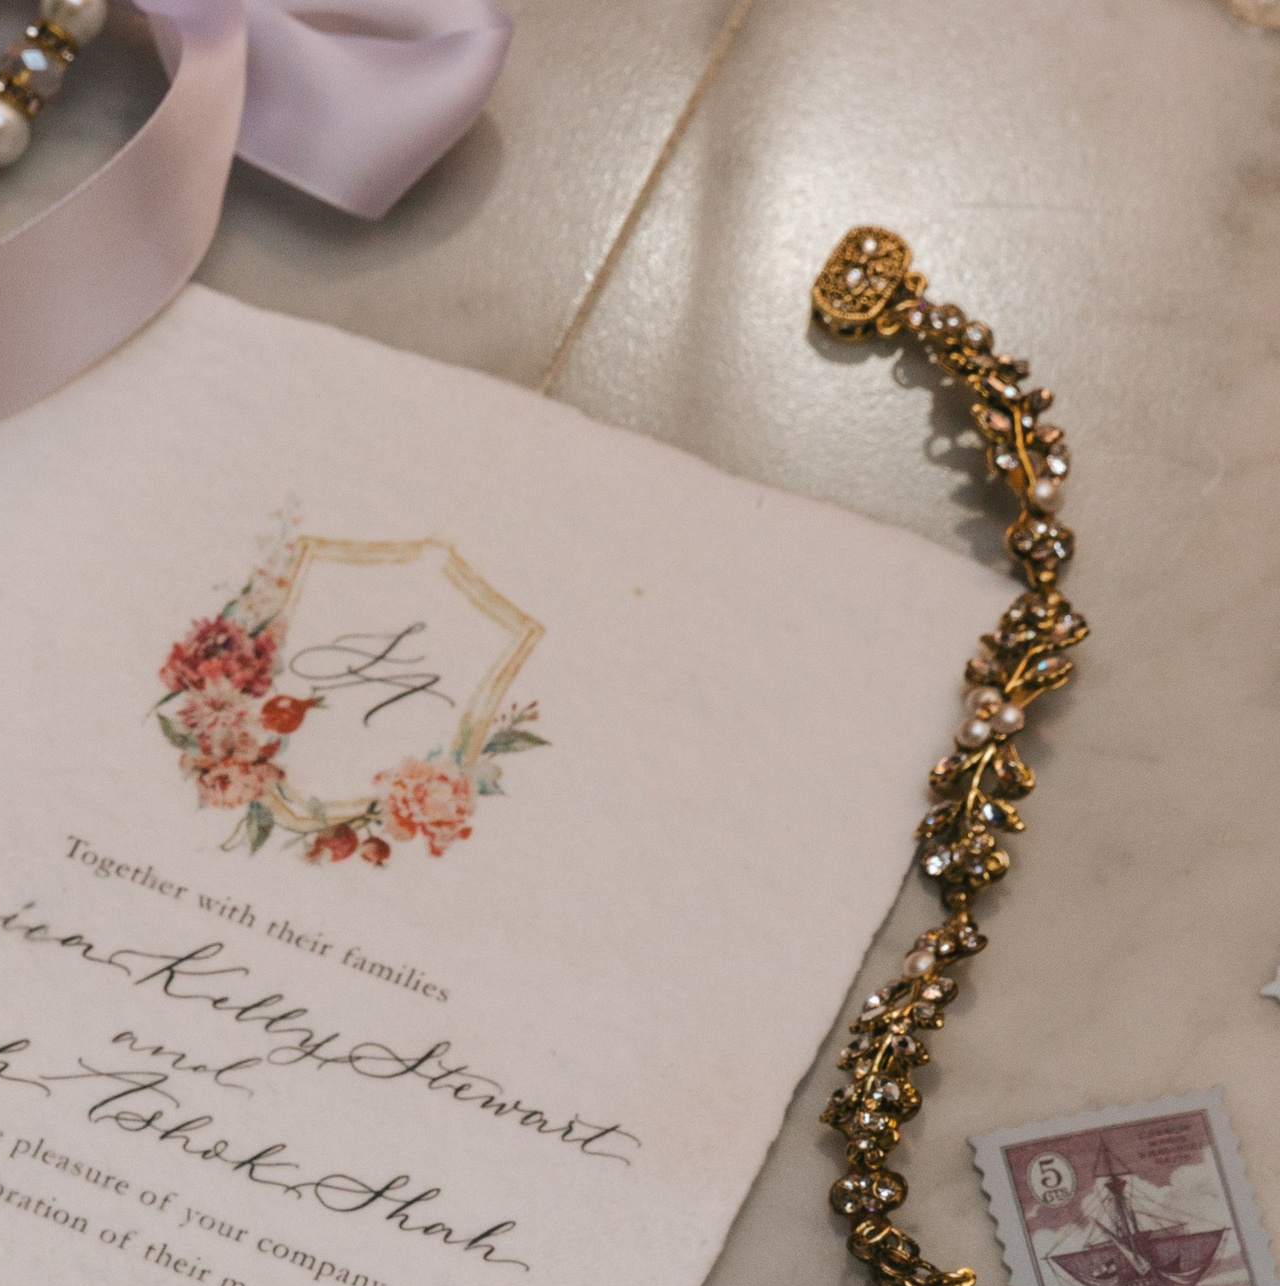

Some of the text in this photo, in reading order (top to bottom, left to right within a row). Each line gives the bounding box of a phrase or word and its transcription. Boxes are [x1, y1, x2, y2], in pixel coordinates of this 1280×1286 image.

[64, 835, 450, 1003] Together with their families
[109, 942, 342, 1069] Kelly
[348, 1040, 642, 1166] Stewart
[111, 1030, 263, 1098] and
[9, 1138, 131, 1196] pleasure
[139, 1190, 179, 1212] of
[179, 1206, 250, 1243] your
[40, 1056, 302, 1200] Ashok
[290, 1174, 530, 1272] Shah
[1037, 1158, 1063, 1189] 5
[99, 1227, 138, 1251] of
[143, 1243, 212, 1283] their
